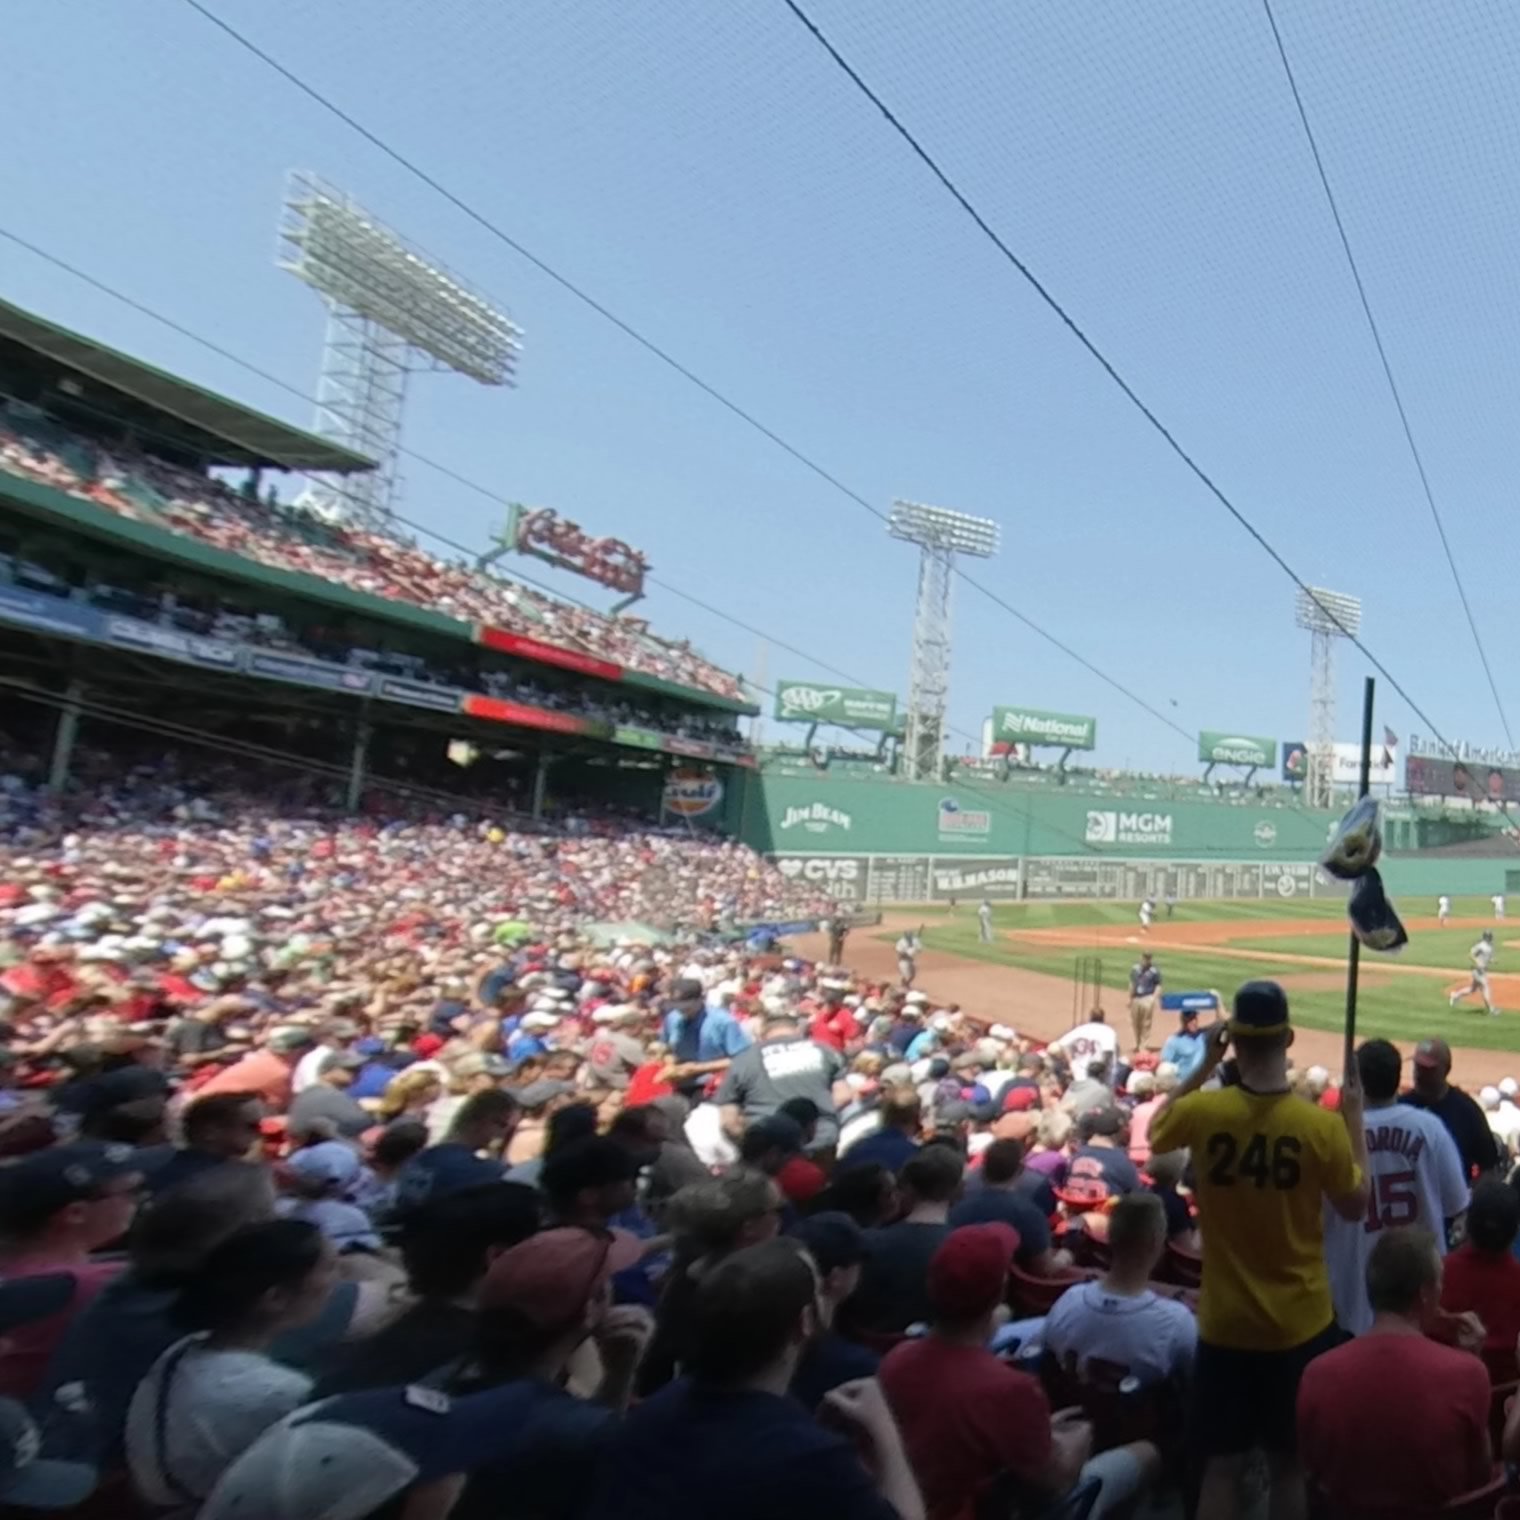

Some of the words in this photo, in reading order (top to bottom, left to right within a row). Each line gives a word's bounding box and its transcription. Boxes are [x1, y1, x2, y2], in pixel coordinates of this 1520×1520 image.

[1023, 716, 1089, 737] National
[780, 806, 810, 829] JIM
[811, 802, 850, 830] BEAM
[1118, 812, 1173, 834] MGM
[804, 859, 858, 879] CVS
[1207, 1131, 1302, 1190] 246
[1363, 1169, 1418, 1234] 15
